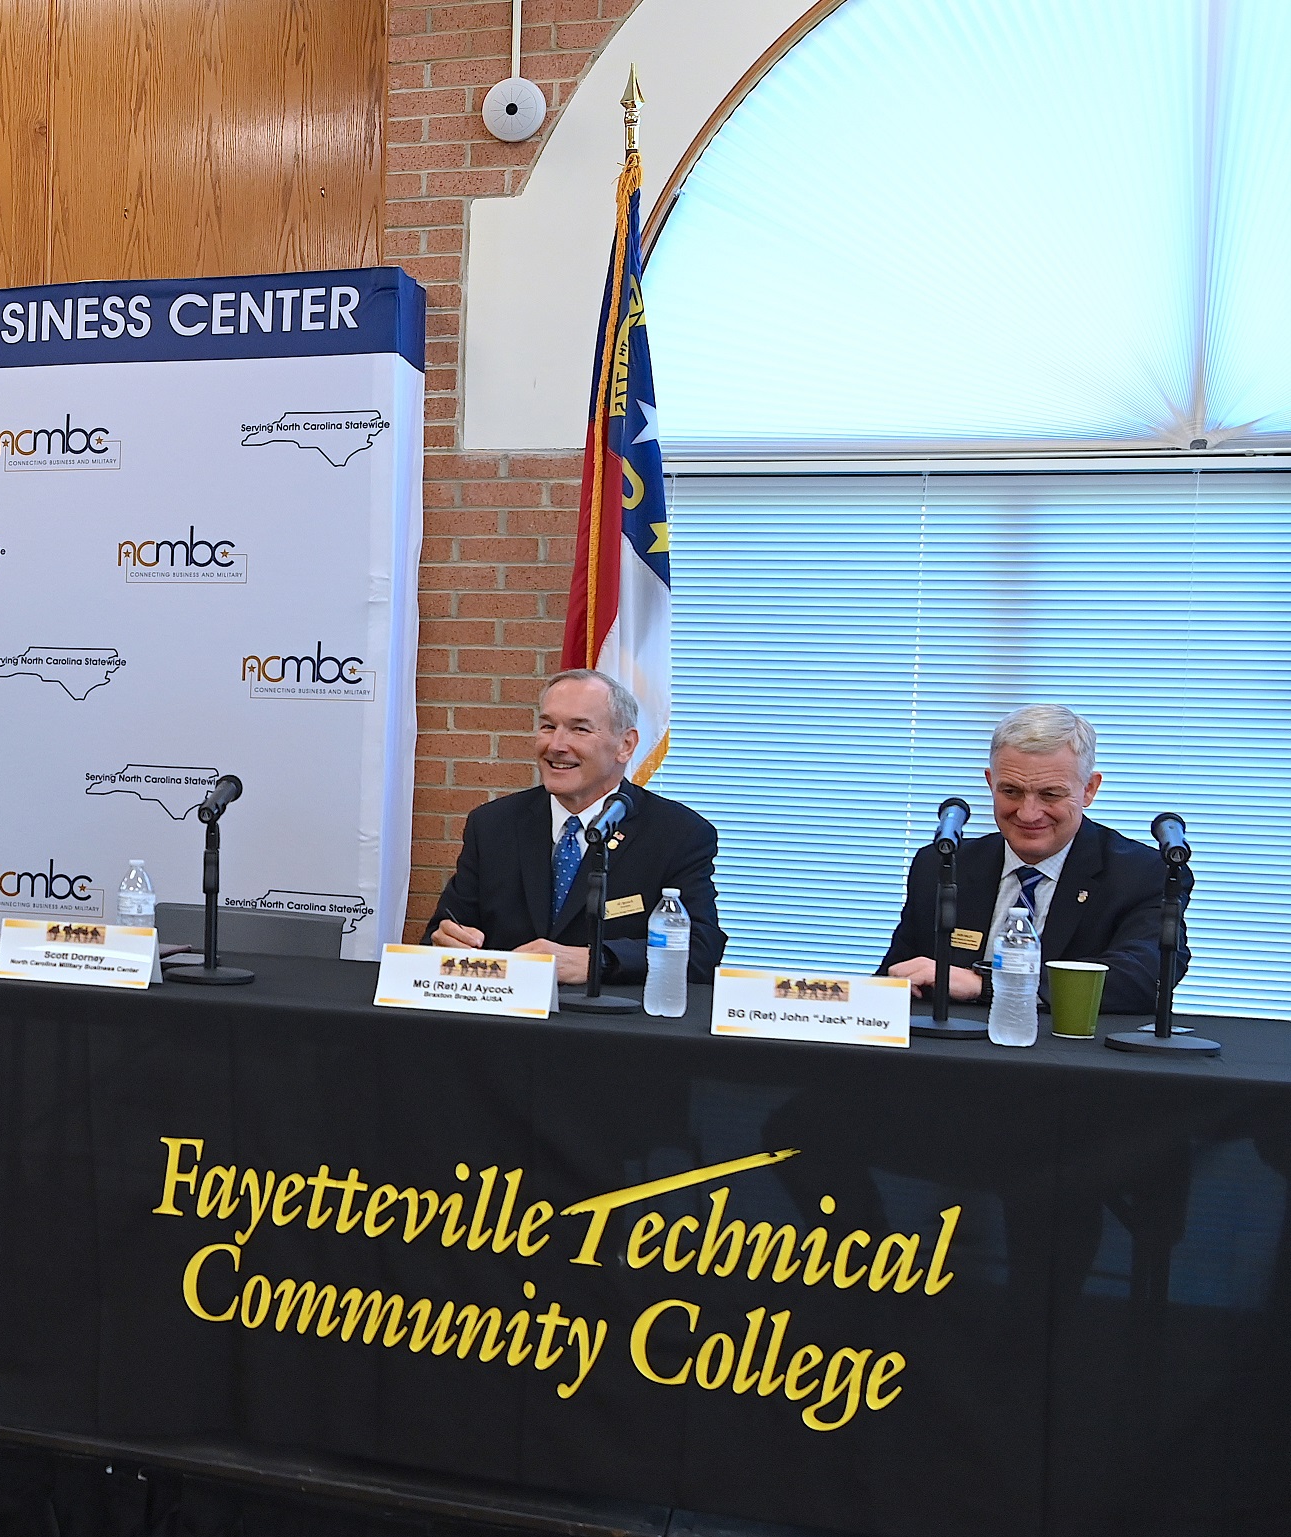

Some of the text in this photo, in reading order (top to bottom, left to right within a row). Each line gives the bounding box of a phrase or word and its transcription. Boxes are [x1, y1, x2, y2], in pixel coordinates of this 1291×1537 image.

[168, 286, 360, 337] CENTER
[241, 420, 390, 433] Serving North Carolina Statewide
[117, 525, 235, 567] ncmbc
[21, 656, 43, 665] North
[46, 657, 82, 665] Carolina
[84, 657, 127, 666] Statewide
[242, 641, 364, 684] ncmbc
[85, 773, 216, 786] Serving North Carolina Statewi
[225, 897, 374, 915] Serving North Carolina Statewide
[30, 959, 57, 967] Carolina
[59, 962, 82, 970] Military
[44, 951, 105, 964] Scott Dorney
[412, 979, 430, 988] MG
[433, 981, 458, 991] (Ret)
[474, 984, 514, 995] Aycock
[727, 1008, 745, 1018] BG
[749, 1009, 777, 1022] (Ret)
[780, 1012, 809, 1022] John
[856, 1016, 890, 1029] Haley
[151, 1136, 962, 1296] Fayetteville Technical
[182, 1243, 906, 1431] Community College
